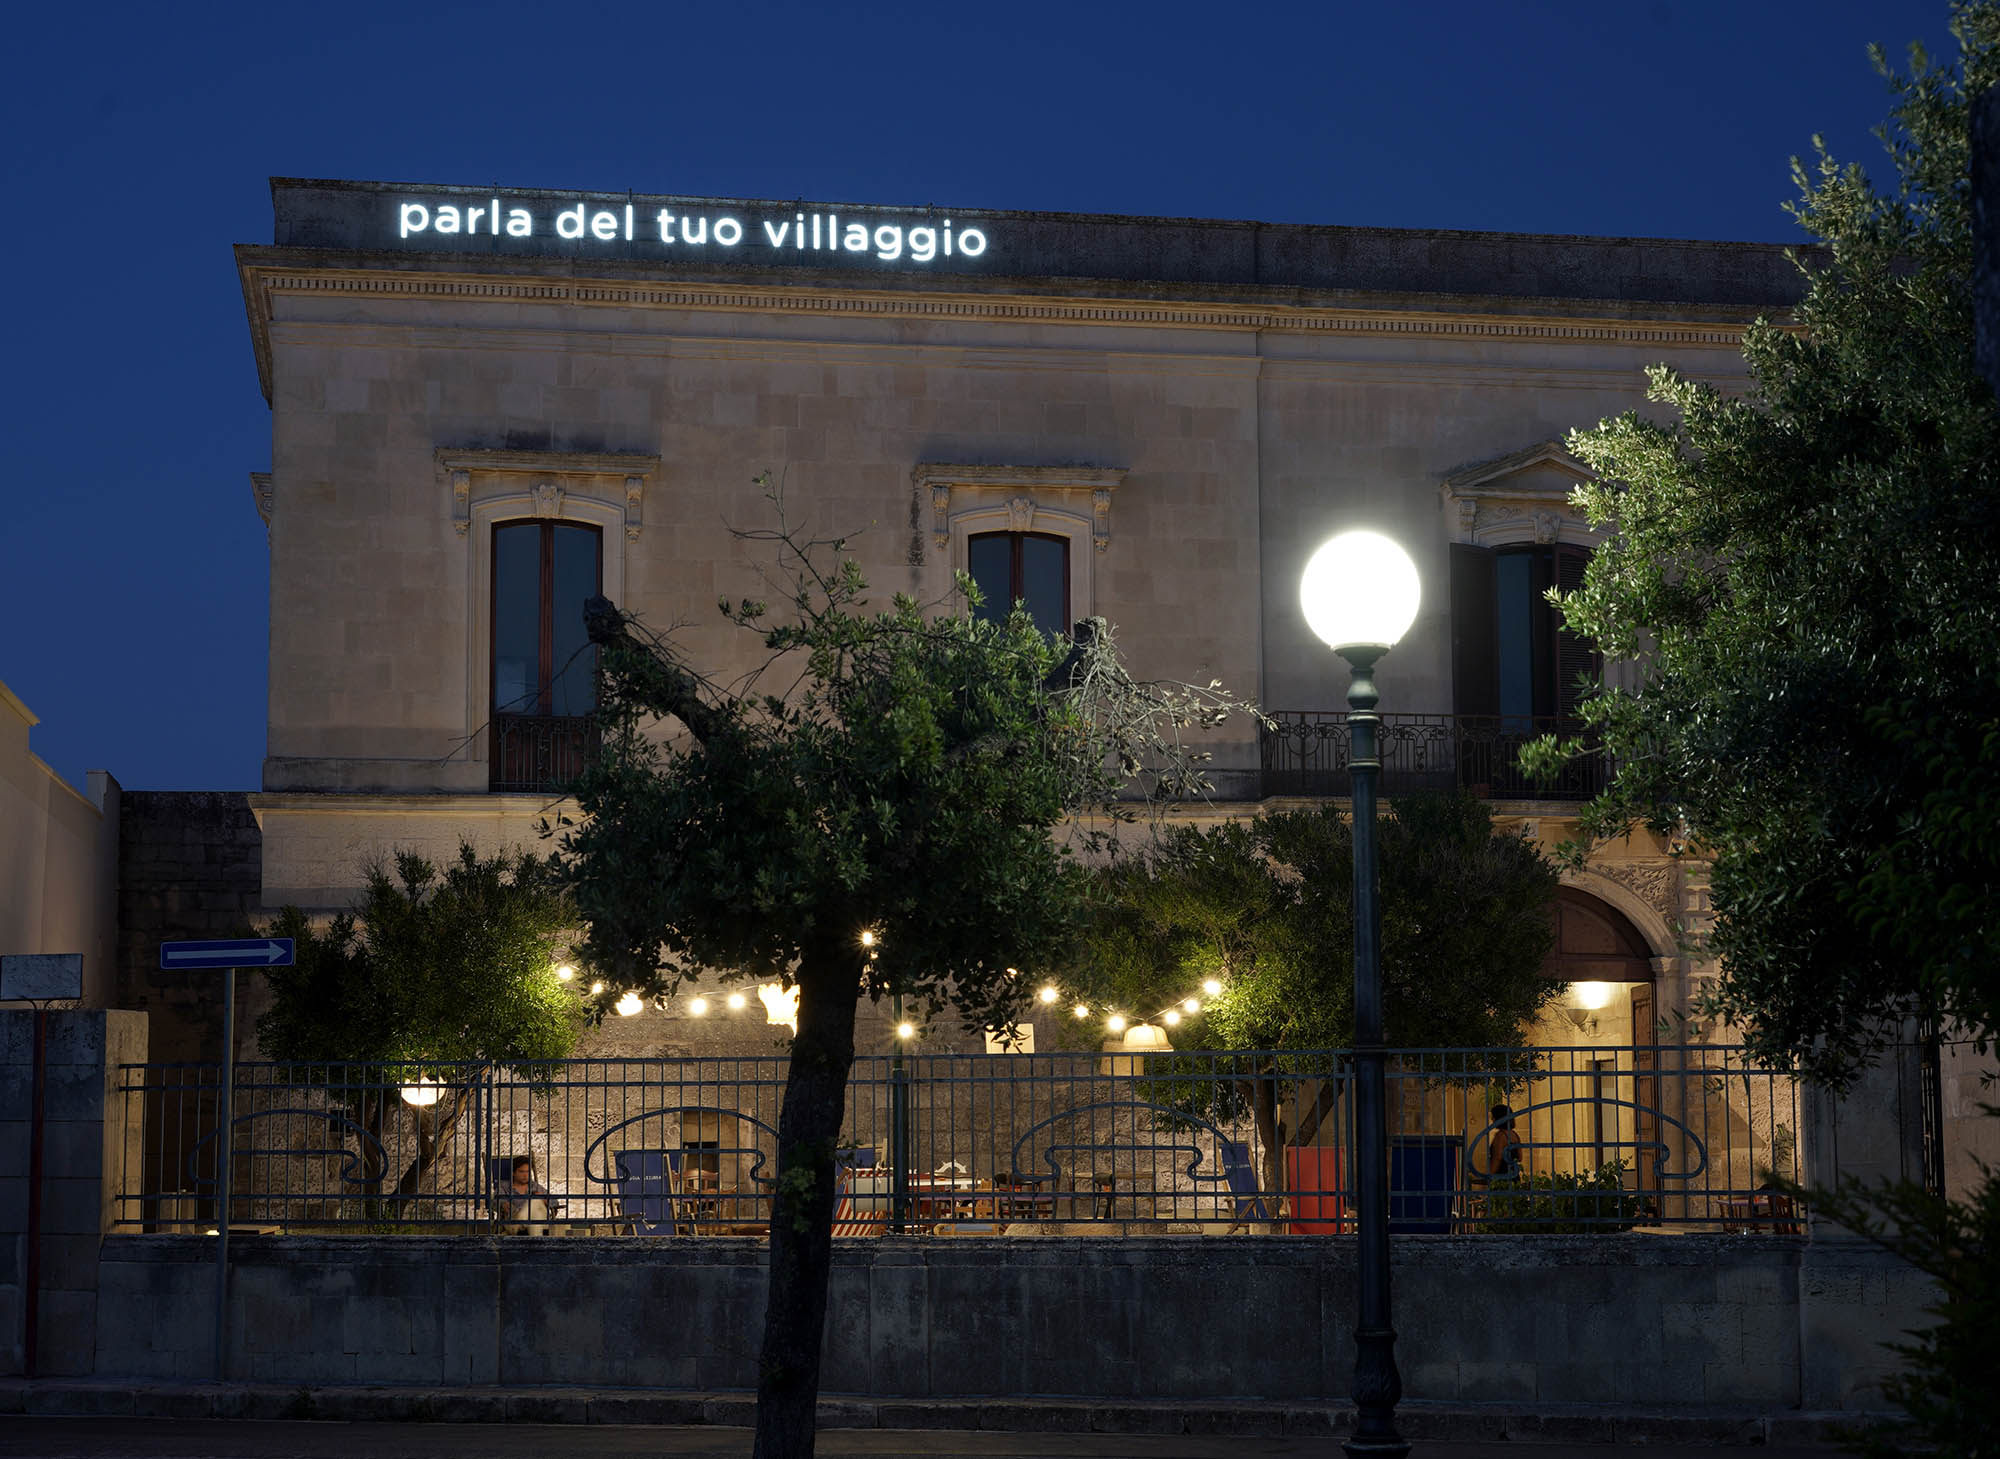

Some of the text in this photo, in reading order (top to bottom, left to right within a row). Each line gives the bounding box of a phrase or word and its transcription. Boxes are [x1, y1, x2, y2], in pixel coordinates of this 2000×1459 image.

[400, 198, 987, 262] parla del tuo villaggio
